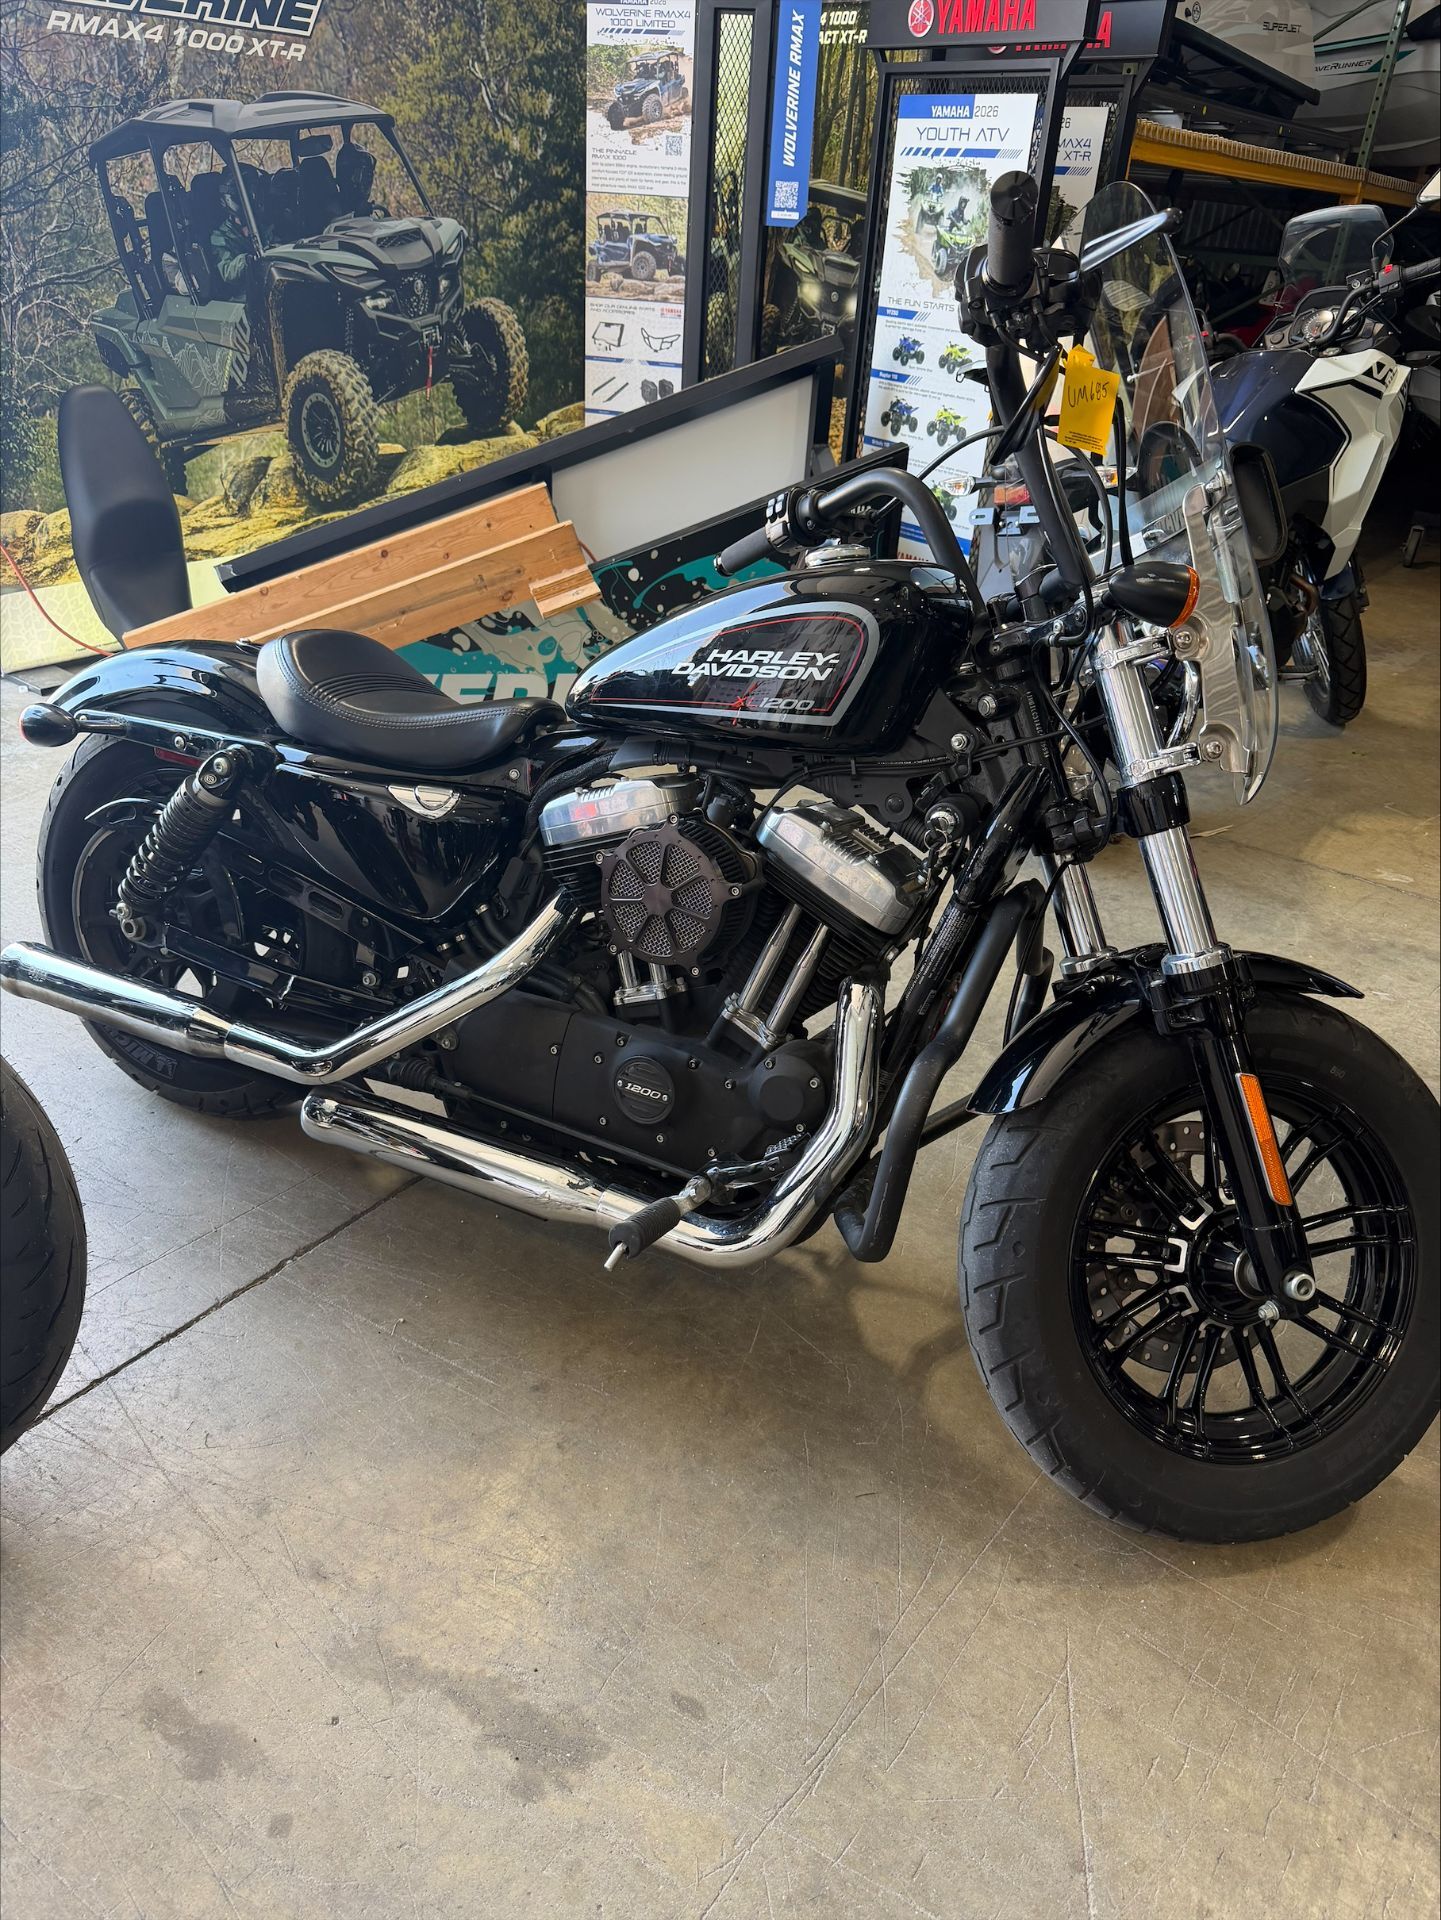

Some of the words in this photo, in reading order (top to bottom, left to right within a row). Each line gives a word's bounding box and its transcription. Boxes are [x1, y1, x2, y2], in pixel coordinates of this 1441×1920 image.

[595, 8, 651, 18] WOLVERINE
[654, 9, 691, 19] RMAX4
[829, 10, 857, 26] 1000
[937, 0, 1036, 34] YAMAHA
[610, 18, 633, 27] 1000
[636, 19, 676, 29] LIMITED
[1262, 21, 1301, 34] SUPERJET
[46, 10, 163, 44] RMAX4
[173, 27, 245, 54] 1000
[247, 37, 307, 62] XT-R
[789, 9, 805, 66] RMAX
[840, 29, 868, 44] XT-R
[1315, 59, 1373, 72] AVERUNNER
[783, 67, 801, 168] WOLVERINE
[931, 105, 970, 118] YAMAHA
[974, 105, 999, 118] 2026
[916, 126, 971, 142] YOUTH
[975, 128, 1010, 142] ATV
[1063, 150, 1092, 161] XT-R
[887, 296, 902, 305] THE
[904, 298, 920, 307] FUN
[923, 301, 955, 312] STARTS
[706, 649, 840, 667] HARLEY-
[671, 662, 834, 682] DAVIDSON
[624, 1081, 661, 1100] 1200
